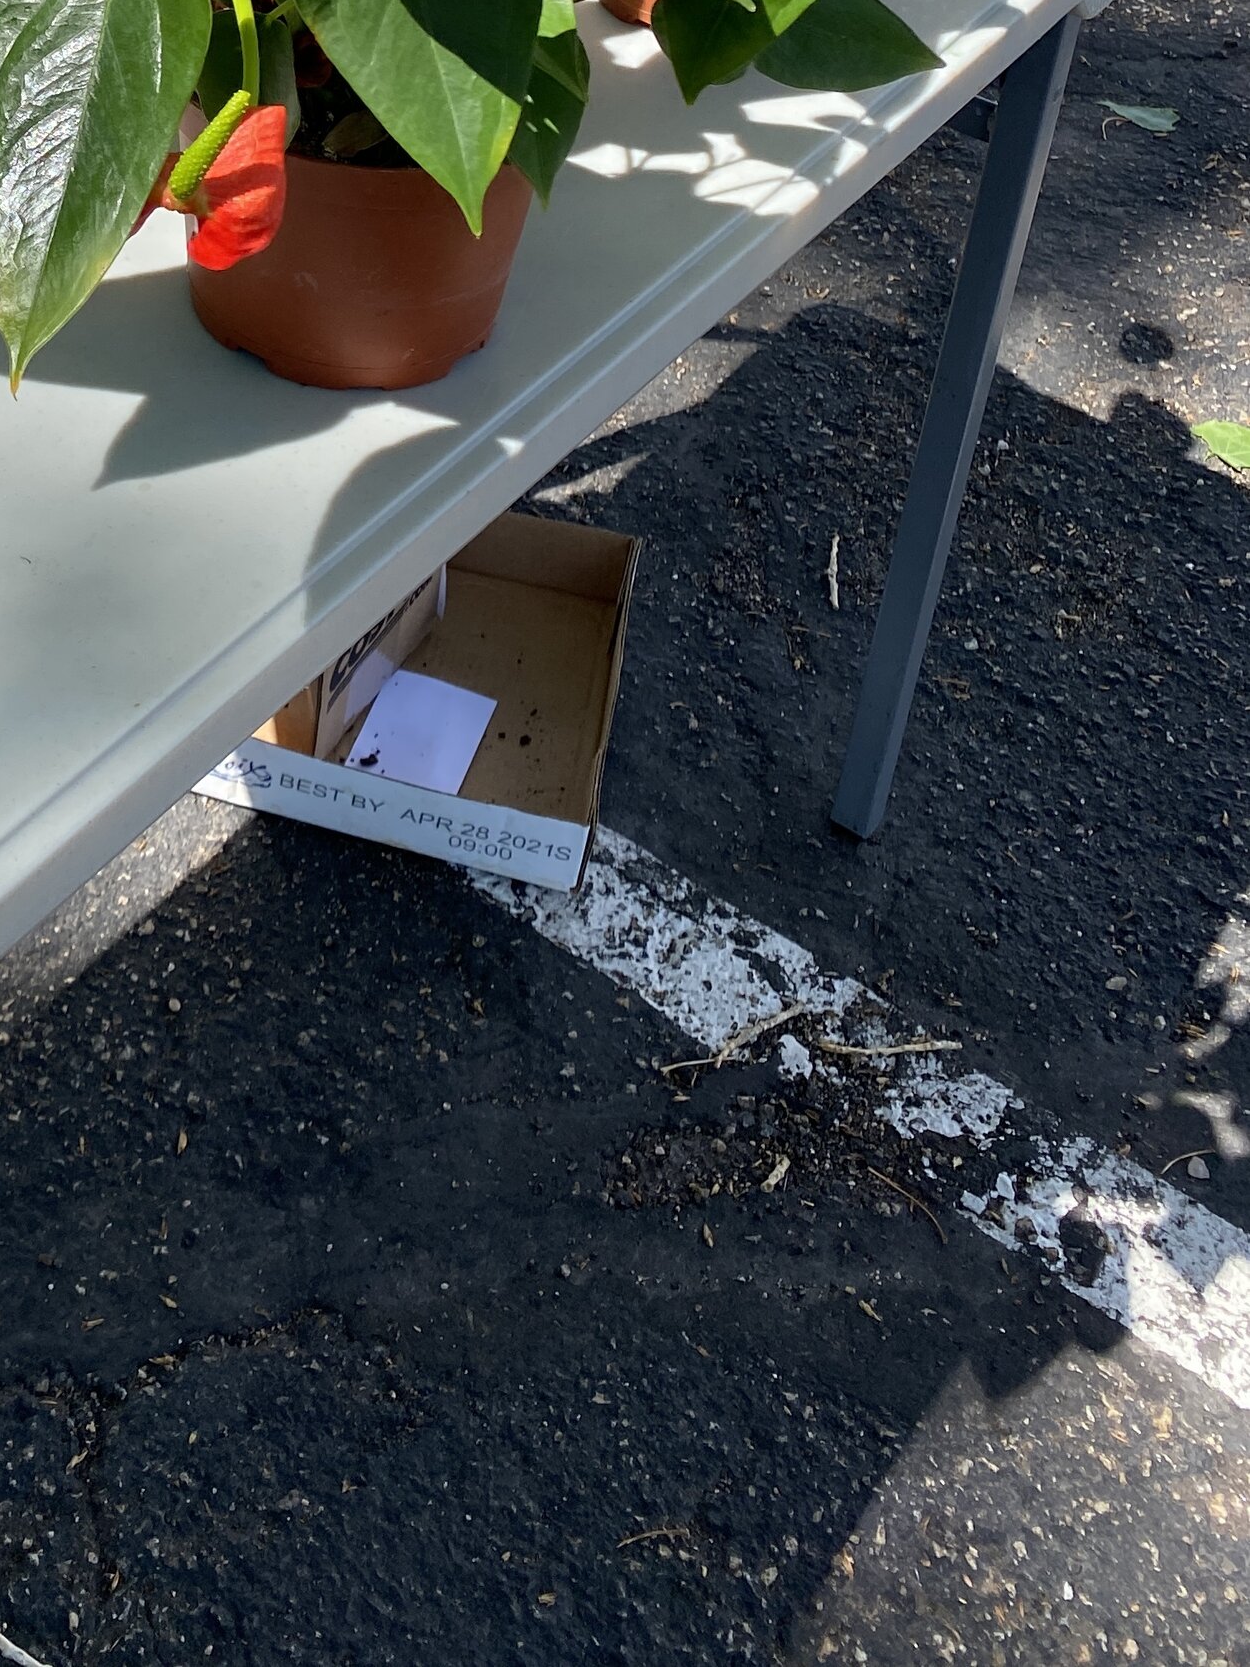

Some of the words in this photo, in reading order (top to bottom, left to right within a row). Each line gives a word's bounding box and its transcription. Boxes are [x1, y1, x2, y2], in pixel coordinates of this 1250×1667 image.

[279, 772, 345, 802] BEST
[351, 794, 386, 813] BY
[399, 808, 454, 833] APR
[460, 822, 490, 841] 28
[497, 831, 573, 862] 2021S
[448, 834, 513, 861] 09:00
